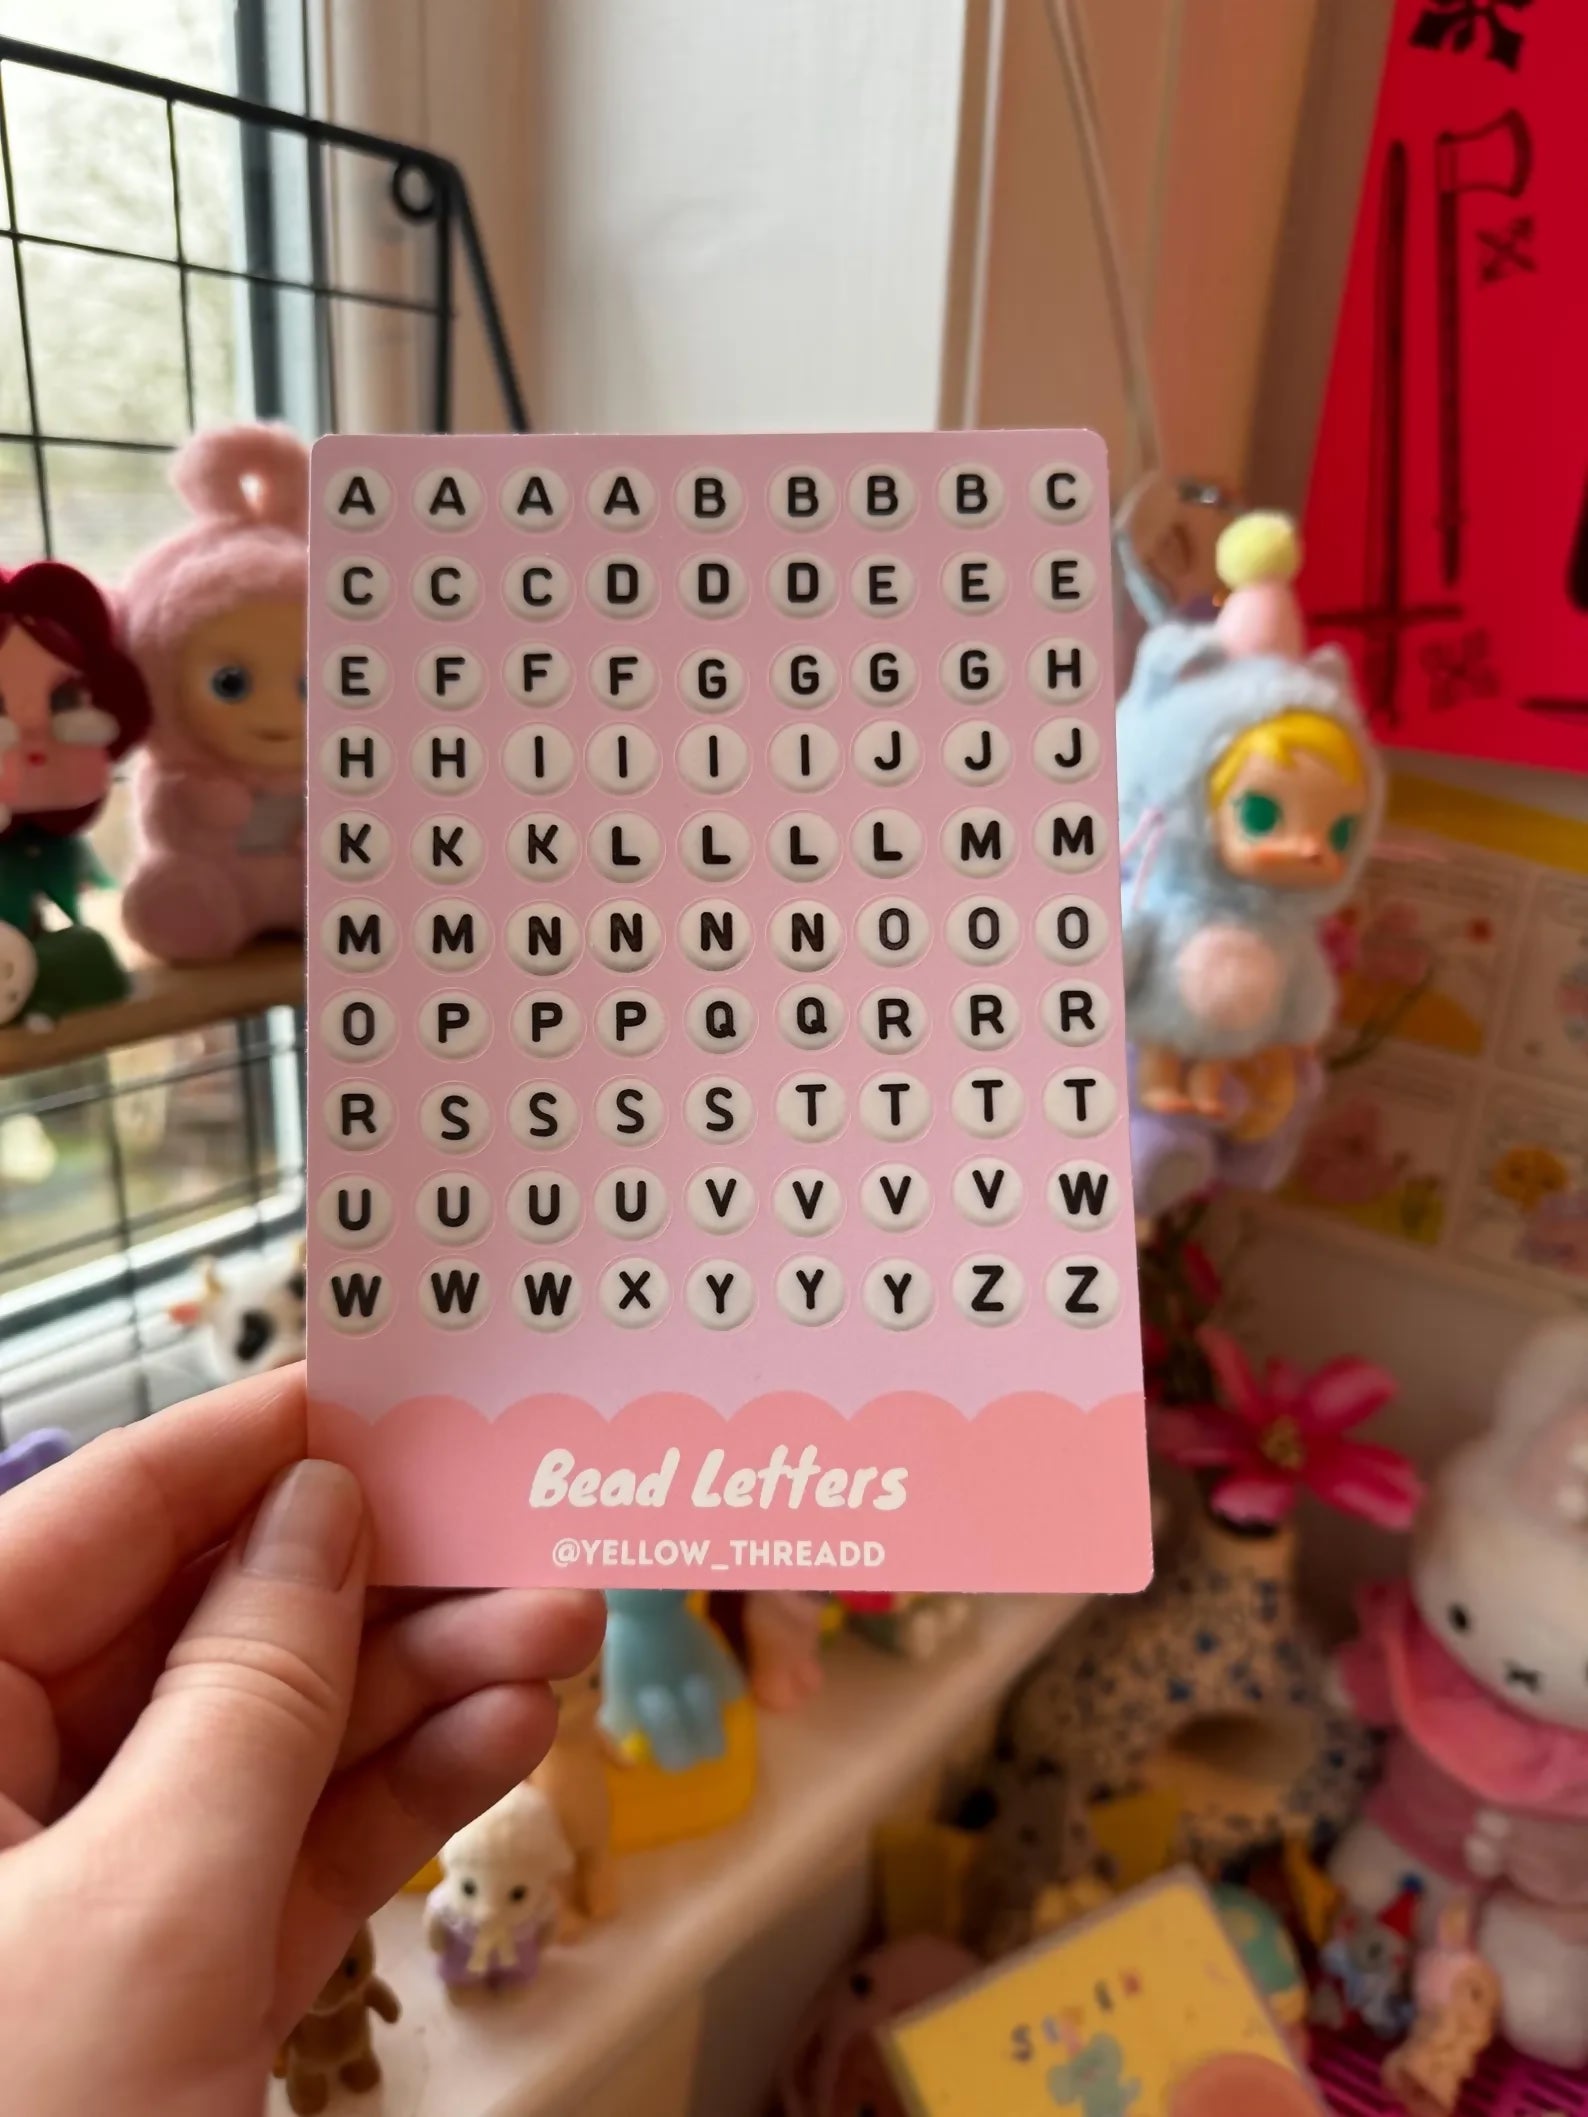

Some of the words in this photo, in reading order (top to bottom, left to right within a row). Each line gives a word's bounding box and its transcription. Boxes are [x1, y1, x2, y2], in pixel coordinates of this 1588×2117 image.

[337, 475, 376, 516] A
[428, 476, 466, 516] A
[516, 475, 554, 516] A
[603, 475, 641, 516] A
[694, 477, 727, 519] B
[787, 476, 820, 518] B
[866, 474, 899, 517] B
[956, 473, 989, 515] B
[1046, 472, 1077, 511] C
[342, 565, 374, 607] C
[430, 566, 462, 607] C
[522, 567, 553, 607] C
[606, 562, 639, 605] D
[697, 562, 730, 605] D
[787, 561, 820, 604] D
[868, 564, 899, 606] E
[960, 562, 991, 603] E
[1050, 559, 1081, 600] E
[340, 655, 371, 697] E
[435, 656, 466, 697] F
[522, 652, 553, 693] F
[609, 655, 639, 696] F
[697, 658, 727, 700] G
[790, 654, 820, 696] G
[869, 651, 900, 693] G
[959, 649, 990, 691] G
[1047, 647, 1082, 690] H
[338, 736, 375, 779] H
[431, 737, 466, 779] H
[873, 730, 902, 771] J
[964, 730, 992, 772] J
[1054, 727, 1082, 769] J
[338, 822, 372, 865] K
[432, 825, 464, 867] K
[527, 823, 559, 865] K
[611, 825, 642, 867] L
[701, 824, 732, 866] L
[789, 825, 820, 866] L
[872, 821, 904, 862] L
[960, 820, 1002, 862] M
[1052, 815, 1095, 857] M
[337, 913, 382, 956] M
[431, 913, 475, 955] M
[528, 915, 562, 957] N
[609, 912, 644, 953] N
[700, 911, 733, 952] N
[791, 912, 825, 953] N
[878, 907, 910, 951] O
[968, 906, 1000, 950] O
[1057, 906, 1089, 950] O
[342, 1001, 376, 1047] O
[437, 1002, 470, 1044] P
[531, 1001, 563, 1043] P
[615, 1000, 647, 1042] P
[705, 1000, 737, 1039] Q
[796, 996, 828, 1035] Q
[877, 998, 912, 1040] R
[969, 994, 1005, 1037] R
[1059, 990, 1096, 1033] R
[340, 1092, 378, 1137] R
[440, 1094, 471, 1141] S
[528, 1091, 559, 1138] S
[615, 1088, 645, 1135] S
[705, 1086, 734, 1133] S
[795, 1083, 827, 1127] T
[878, 1083, 911, 1126] T
[971, 1079, 1004, 1123] T
[1063, 1078, 1097, 1122] T
[337, 1188, 372, 1232] U
[436, 1185, 470, 1228] U
[528, 1183, 561, 1226] U
[615, 1180, 647, 1223] U
[704, 1178, 737, 1218] V
[792, 1180, 824, 1220] V
[879, 1175, 912, 1215] V
[971, 1169, 1005, 1209] V
[1058, 1171, 1109, 1216] W
[330, 1272, 382, 1319] W
[430, 1269, 481, 1315] W
[523, 1271, 573, 1317] W
[618, 1270, 651, 1310] X
[705, 1273, 734, 1315] Y
[795, 1268, 825, 1310] Y
[883, 1272, 912, 1315] Y
[971, 1264, 1005, 1312] Z
[1065, 1265, 1099, 1314] Z
[528, 1447, 681, 1508] Bead
[690, 1444, 909, 1511] Letters
[551, 1537, 886, 1571] @YELLOW_THREADD
